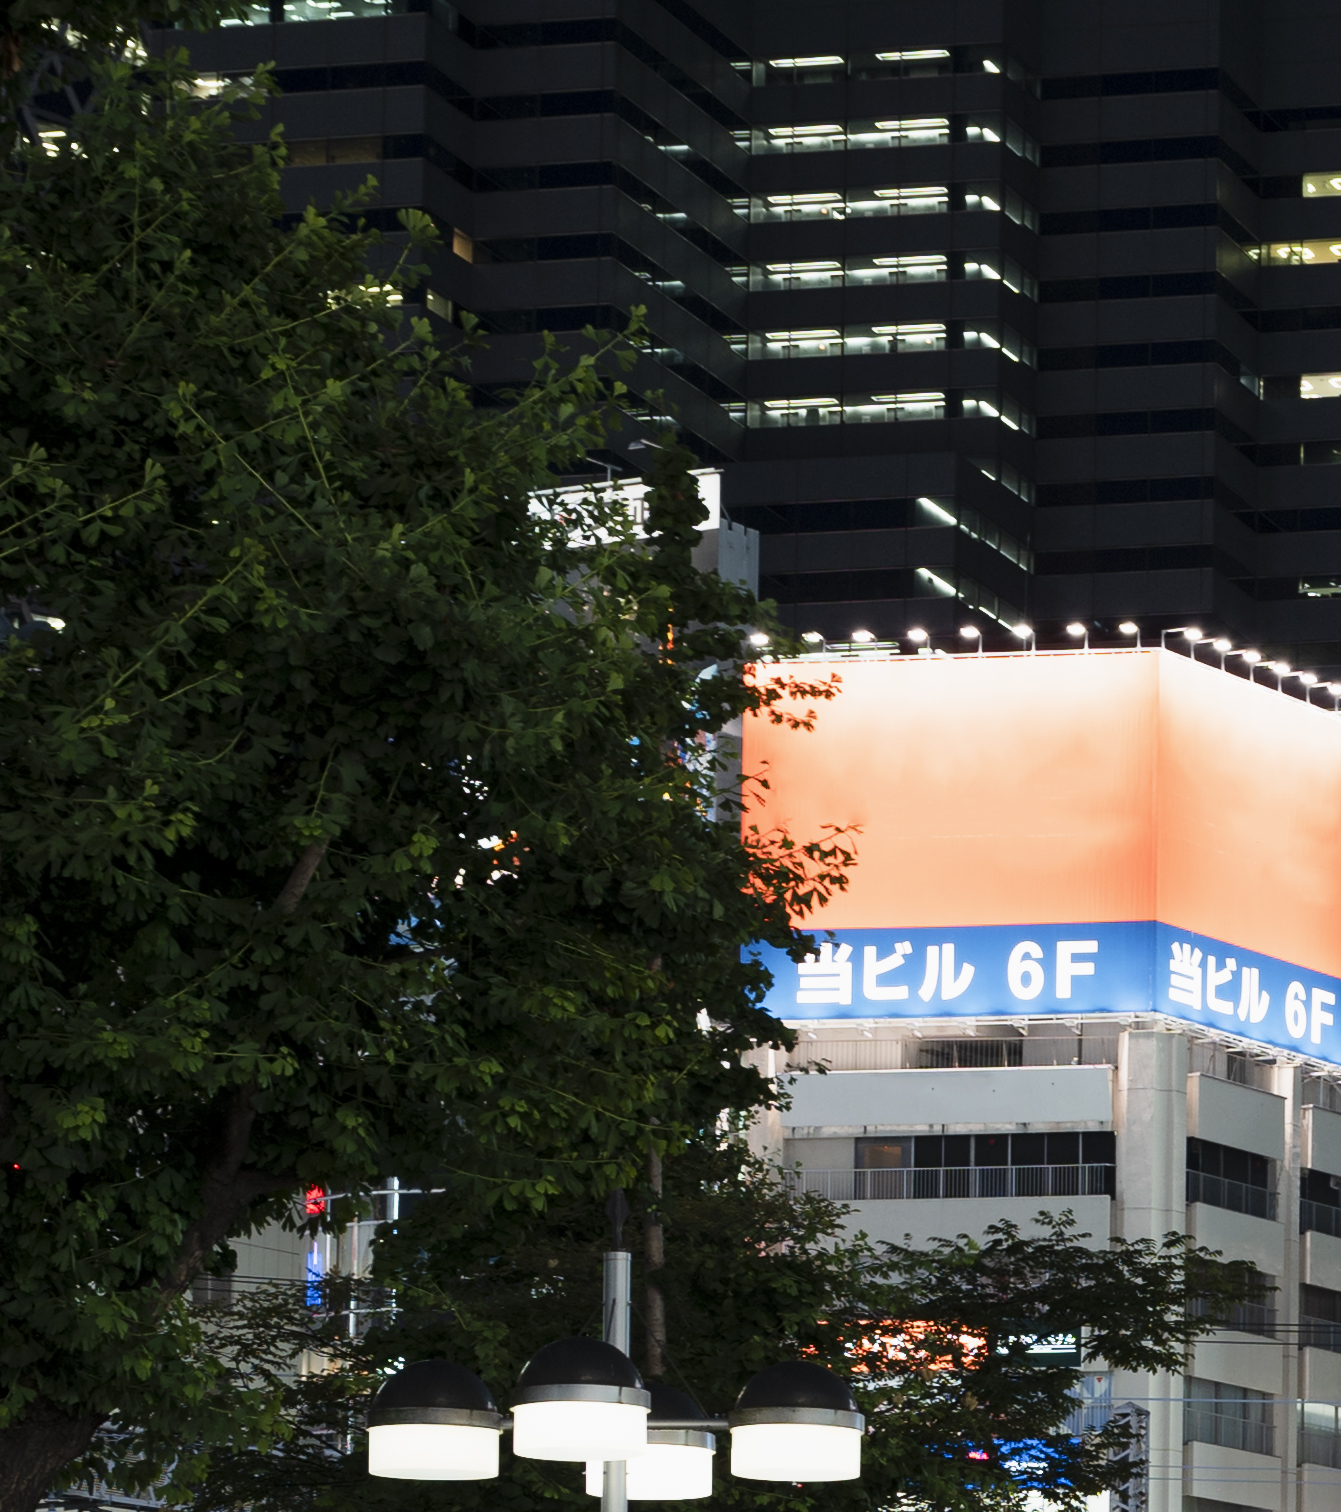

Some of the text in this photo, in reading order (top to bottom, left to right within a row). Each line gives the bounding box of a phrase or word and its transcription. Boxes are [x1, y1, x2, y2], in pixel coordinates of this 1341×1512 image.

[796, 940, 1099, 1007] 当ビル 6F
[1168, 941, 1337, 1046] 当ビル 6F
